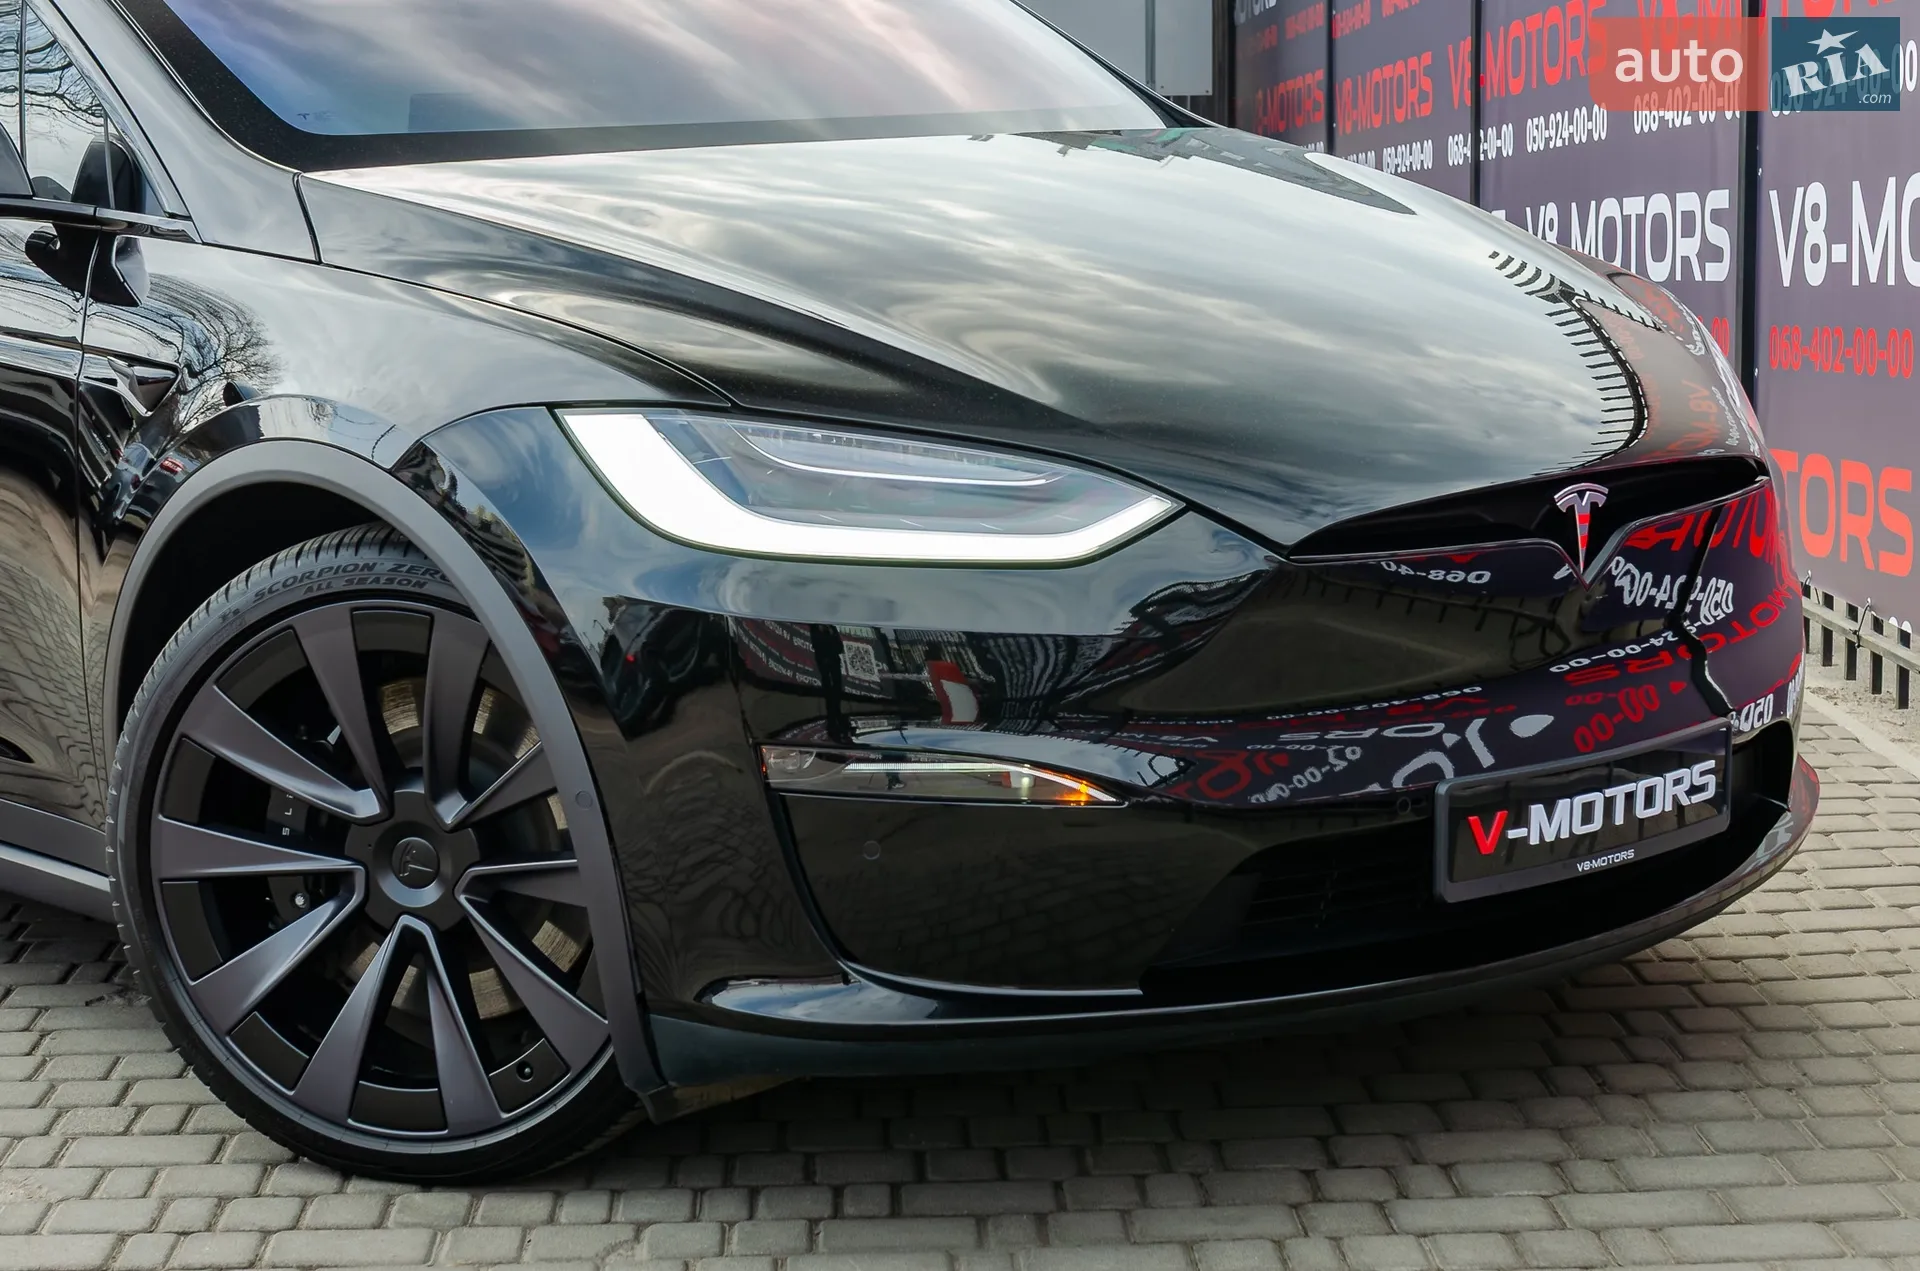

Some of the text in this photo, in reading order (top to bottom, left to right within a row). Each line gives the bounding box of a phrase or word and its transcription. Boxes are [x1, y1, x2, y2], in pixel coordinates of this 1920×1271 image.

[1335, 51, 1433, 136] V8-MOTORS
[1447, 122, 1514, 167] 068-42-00-00
[1525, 102, 1608, 154] 050-924-00-00
[1525, 188, 1731, 283] V8MOTORS
[1769, 325, 1914, 379] 068-402-00-00
[254, 562, 376, 602] SCORPION
[302, 576, 429, 597] ALL SEASON
[1467, 759, 1717, 856] V-MOTORS
[1576, 848, 1636, 873] V8-MOTORS
